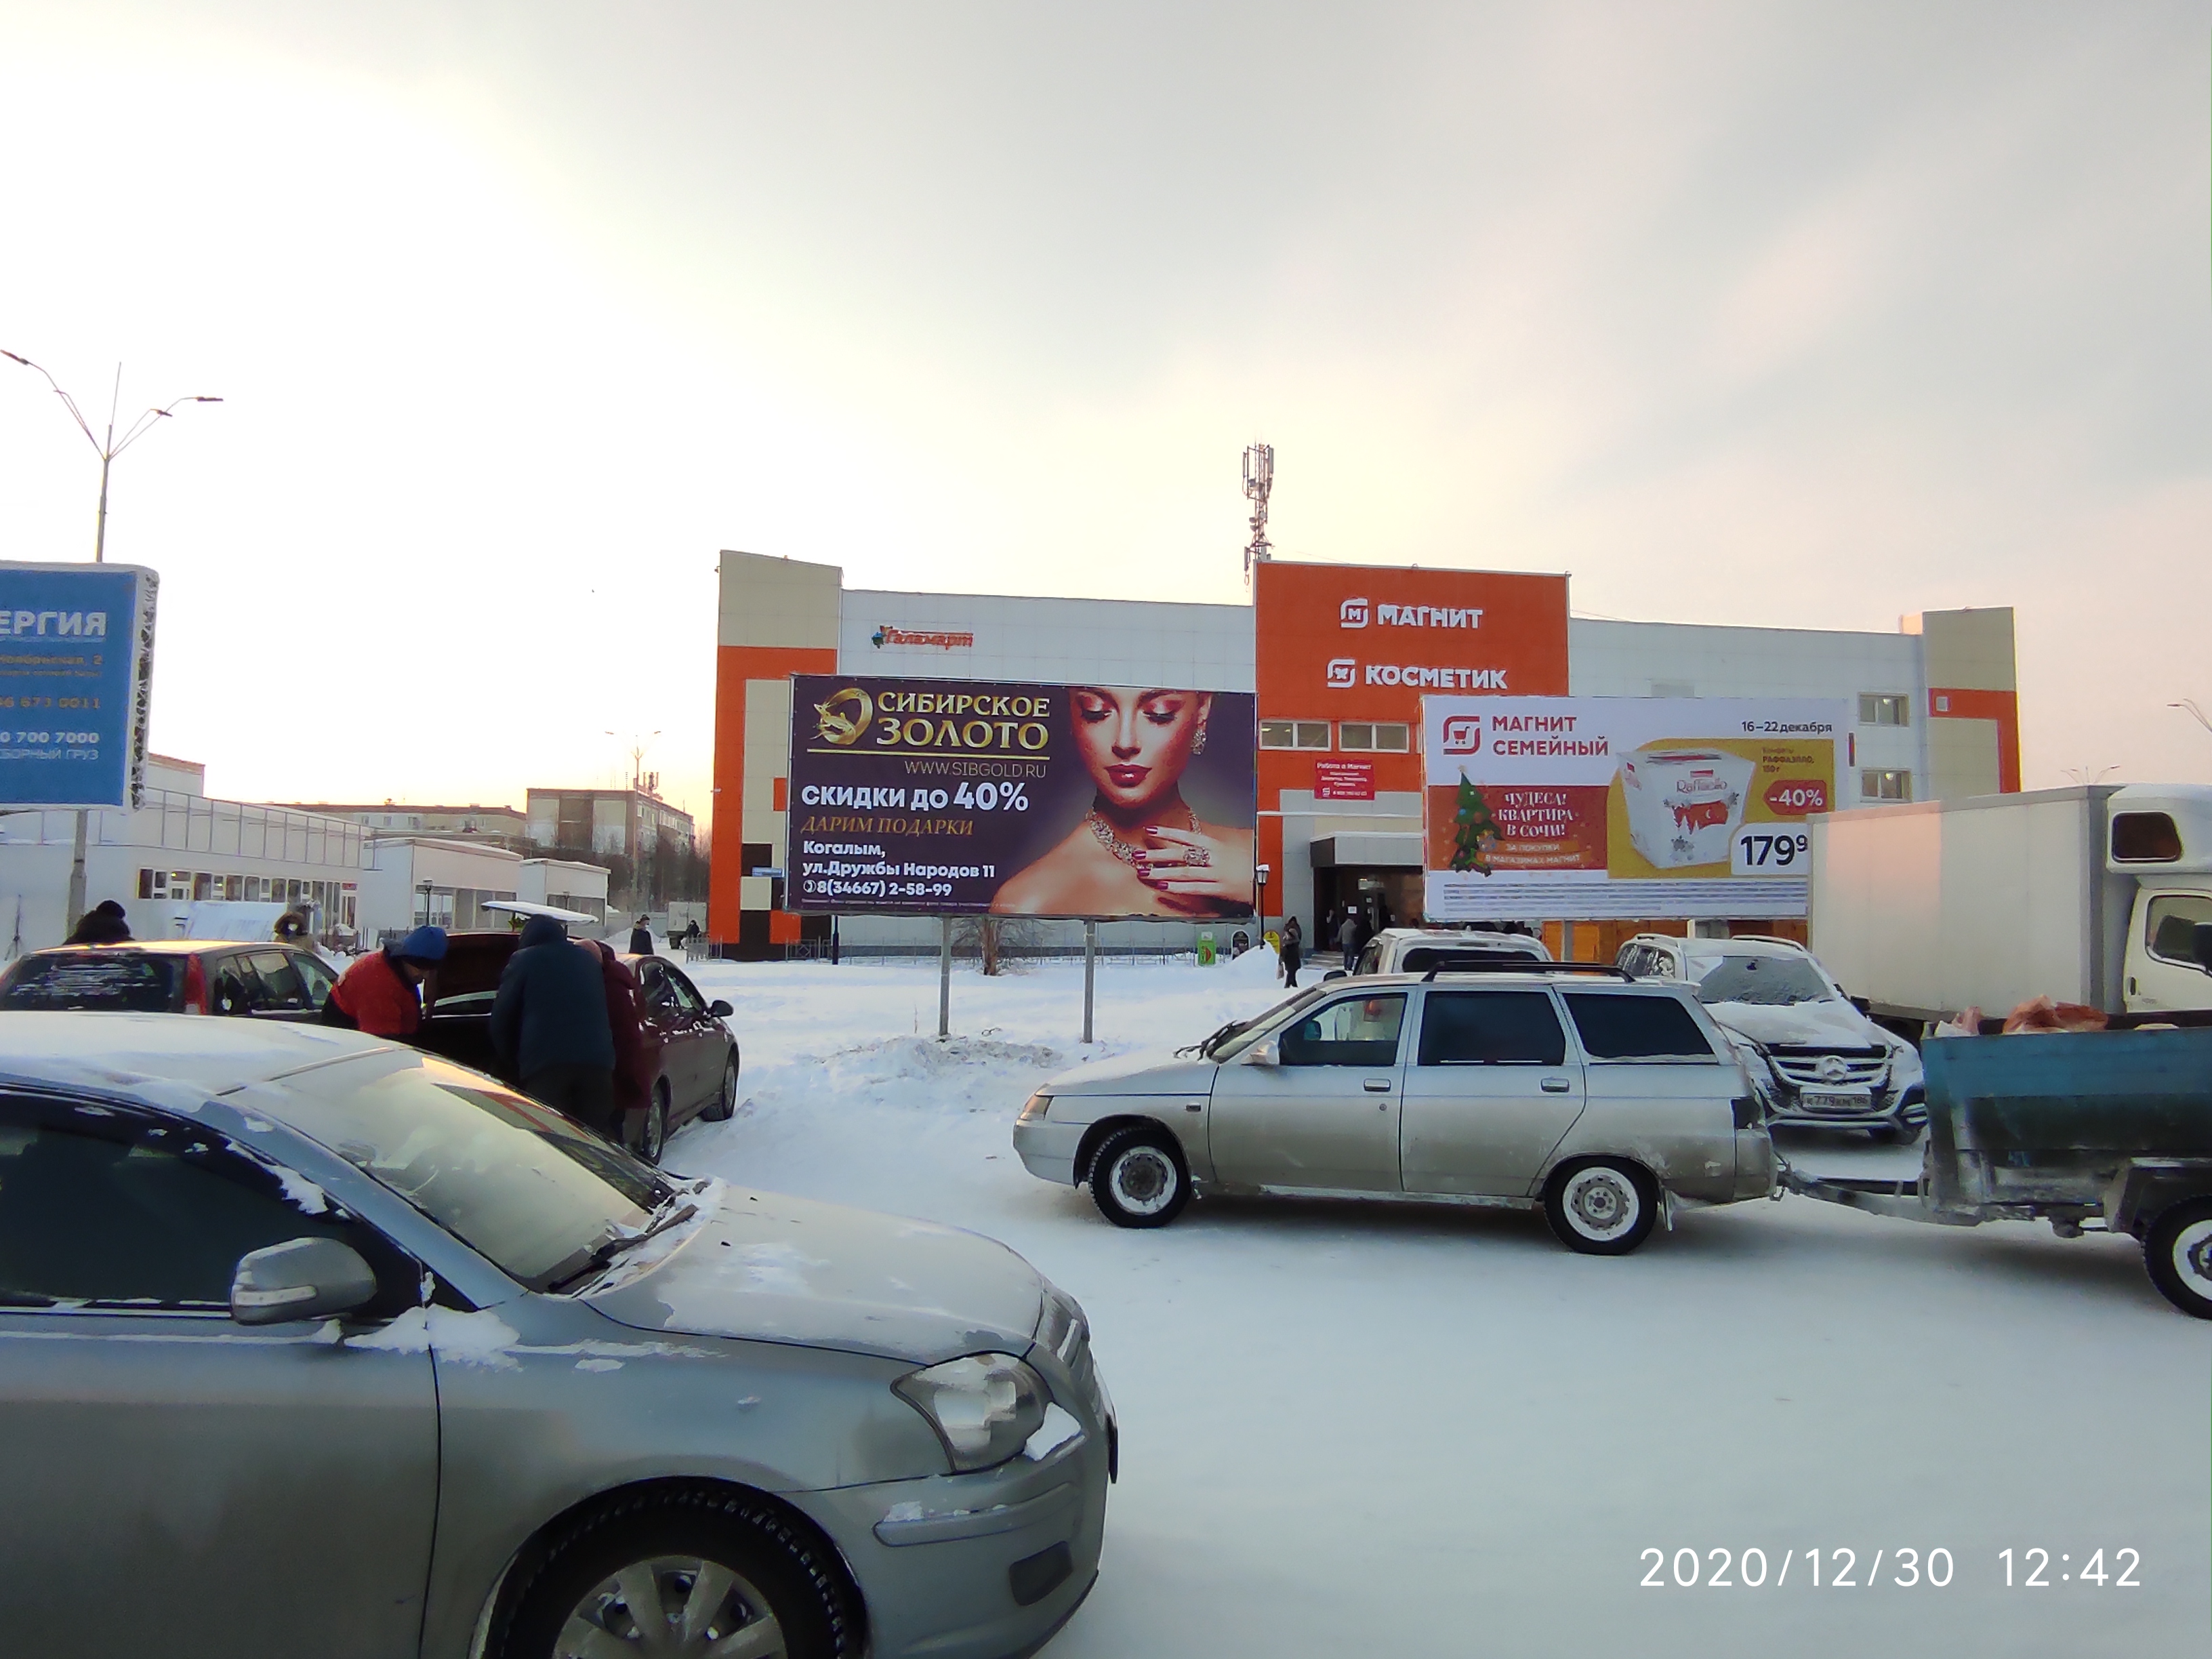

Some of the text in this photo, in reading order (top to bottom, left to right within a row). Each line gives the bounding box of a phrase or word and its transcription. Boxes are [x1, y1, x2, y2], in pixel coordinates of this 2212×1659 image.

[1377, 604, 1483, 629] МАГНИТ
[1365, 664, 1508, 689] КОСМЕТИК
[878, 691, 1050, 718] СИБИРСКОЕ
[1492, 716, 1578, 732] МАГНИТ
[1779, 722, 1832, 735] декабря
[16, 732, 49, 743] 700
[55, 732, 100, 744] 7000
[876, 716, 1049, 750] ЗОЛОТО
[1493, 735, 1609, 756] СЕМЕЙНЫЙ
[904, 760, 1047, 779] WWW.SIBGOLD.RU
[953, 781, 1029, 811] 40%
[1504, 791, 1567, 808] ЧУДЕСА!
[1769, 789, 1823, 806] -40%
[1498, 808, 1574, 823] КВАРТИРА
[800, 816, 975, 837] ДАРИМ ПОДАРКИ
[1507, 824, 1565, 838] В СОЧИ!
[803, 840, 886, 858] Когалым,
[903, 863, 980, 879] Народов
[982, 865, 996, 878] 11
[888, 883, 952, 897] 2-58-99
